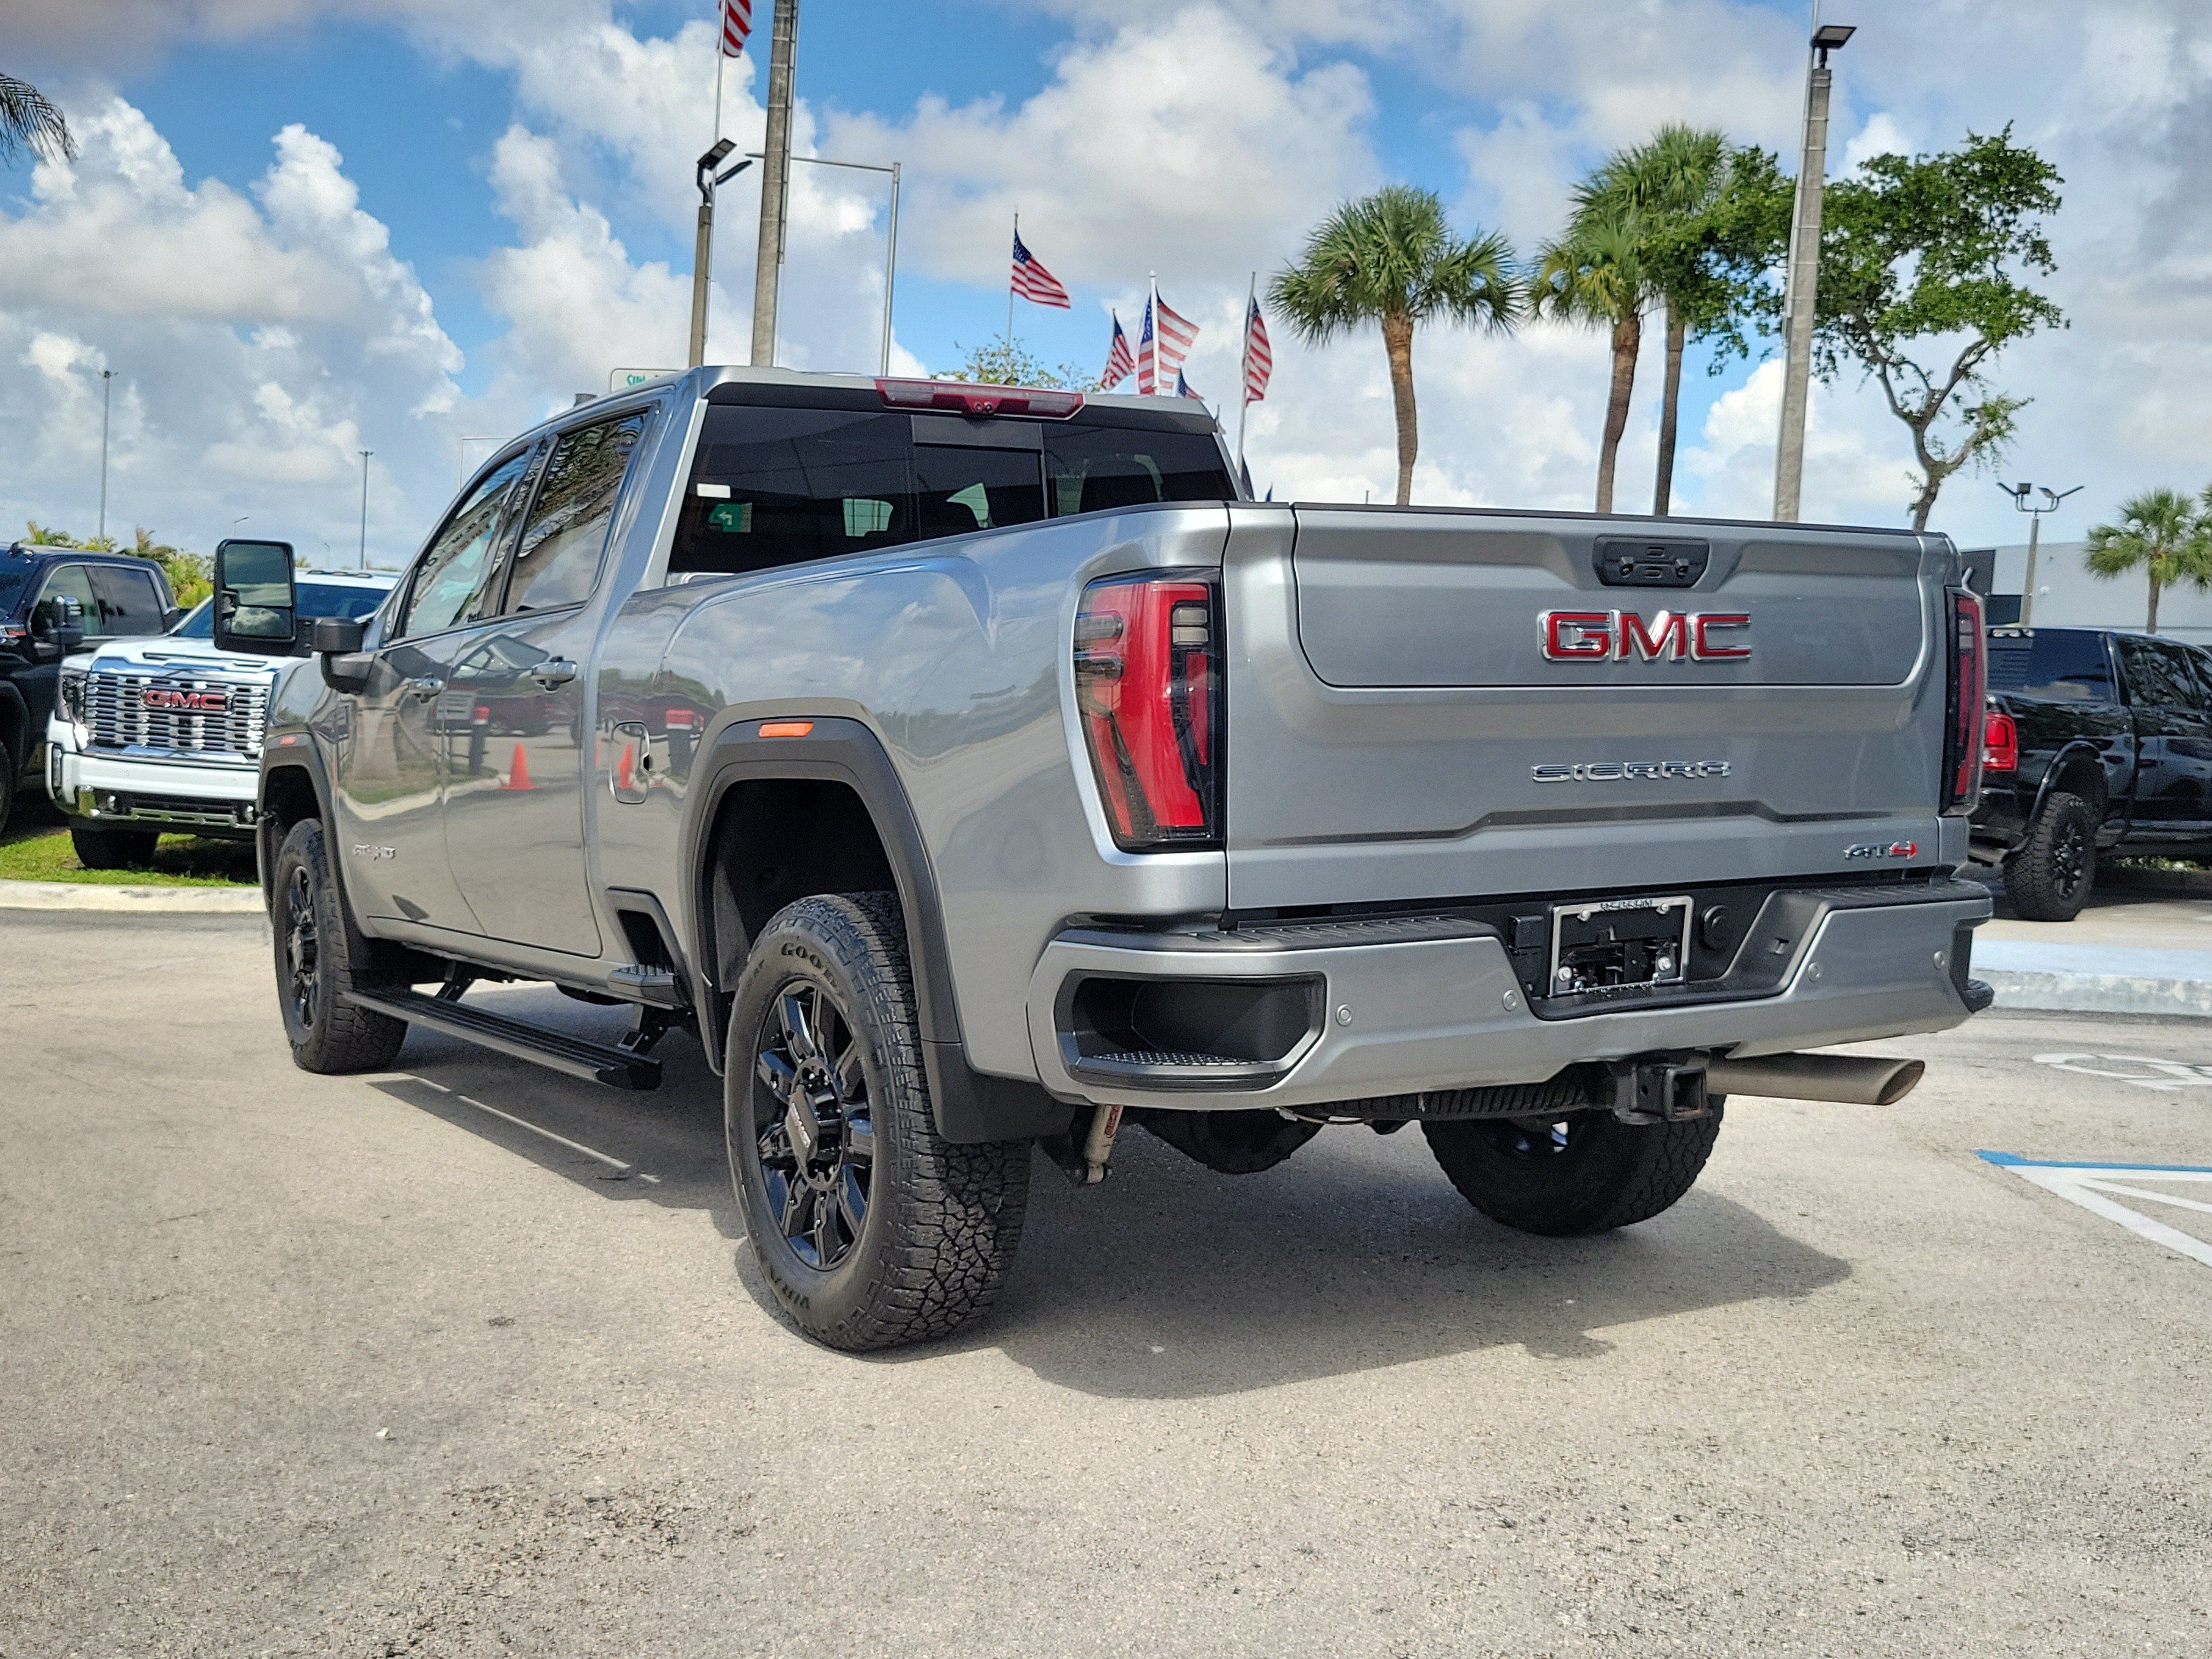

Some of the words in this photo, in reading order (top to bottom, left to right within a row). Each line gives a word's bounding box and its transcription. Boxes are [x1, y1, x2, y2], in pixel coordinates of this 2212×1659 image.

[1537, 609, 1752, 663] GMC
[145, 690, 226, 711] GMC
[1532, 760, 1731, 783] SIERRA
